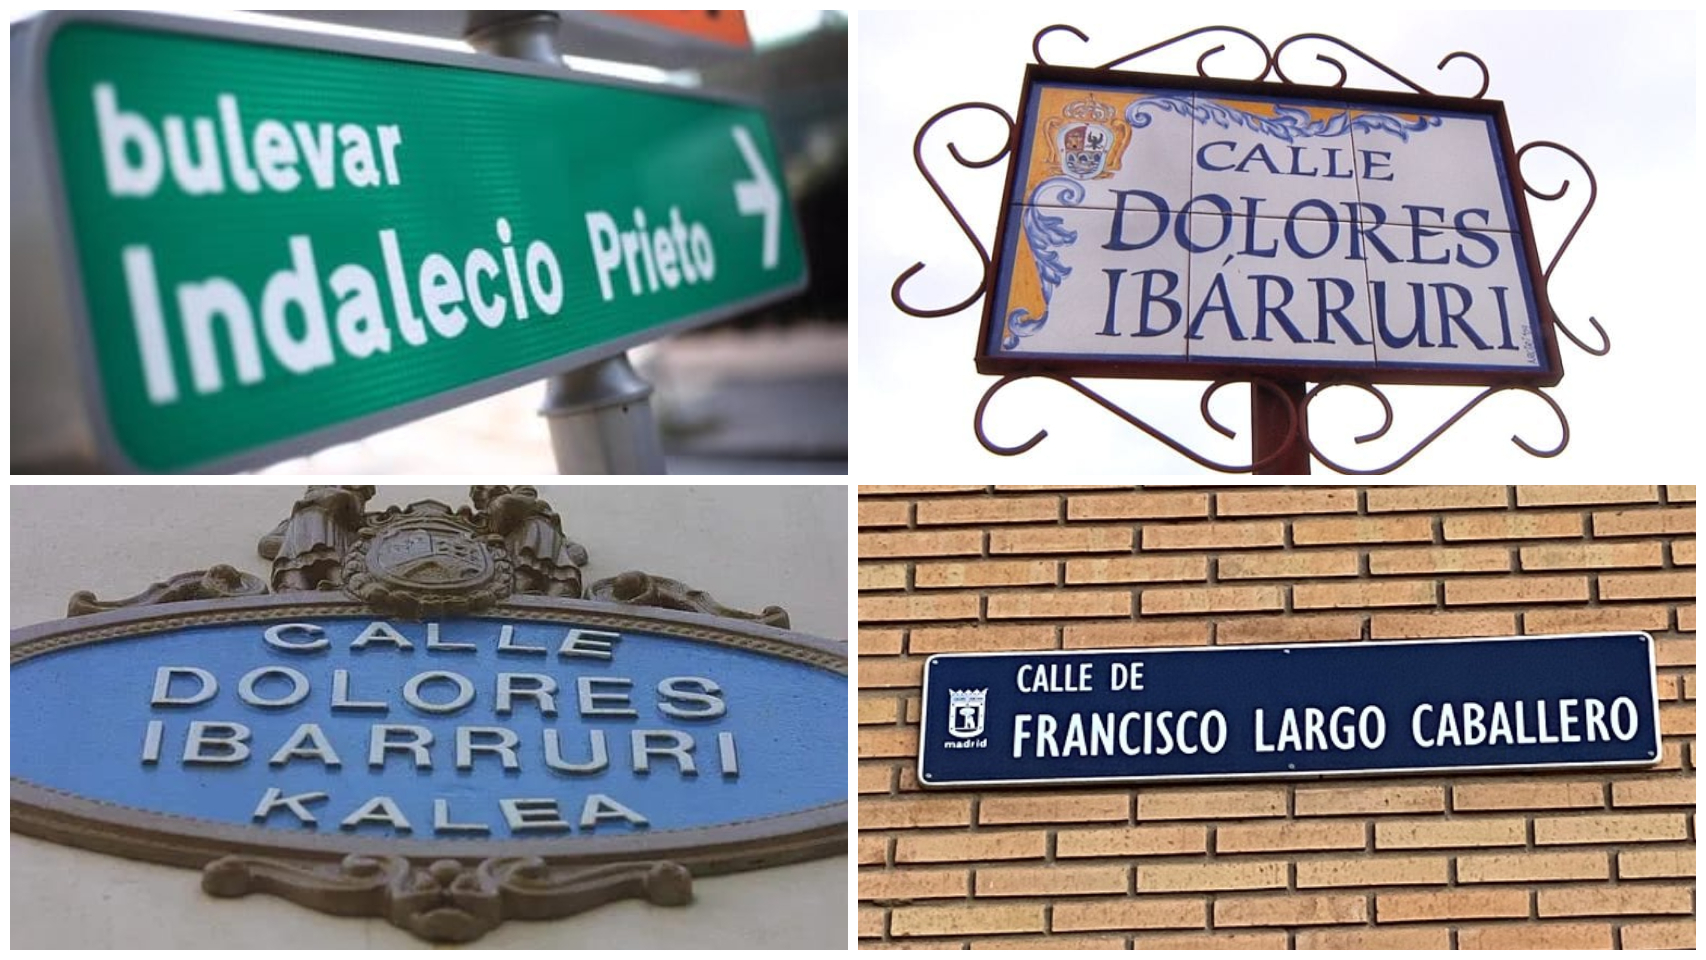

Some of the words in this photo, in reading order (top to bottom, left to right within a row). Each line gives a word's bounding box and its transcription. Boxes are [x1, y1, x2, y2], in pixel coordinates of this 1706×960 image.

[93, 82, 402, 198] bulevar
[1196, 140, 1395, 182] CALLE
[1102, 188, 1501, 269] DOLORES
[122, 217, 564, 404] Indalecio
[585, 204, 716, 302] Prieto
[1094, 252, 1520, 352] IBÁRRURI
[262, 620, 623, 660] CALLE
[148, 666, 728, 720] DOLORES
[1016, 664, 1094, 693] CALLE
[1110, 662, 1145, 691] DE
[140, 719, 740, 778] IBARRURI
[943, 737, 988, 749] madrid
[1012, 708, 1228, 759] FRANCISCO
[1254, 705, 1387, 753] LARGO
[1411, 695, 1640, 749] CABALLERO
[252, 786, 650, 834] KALEA
